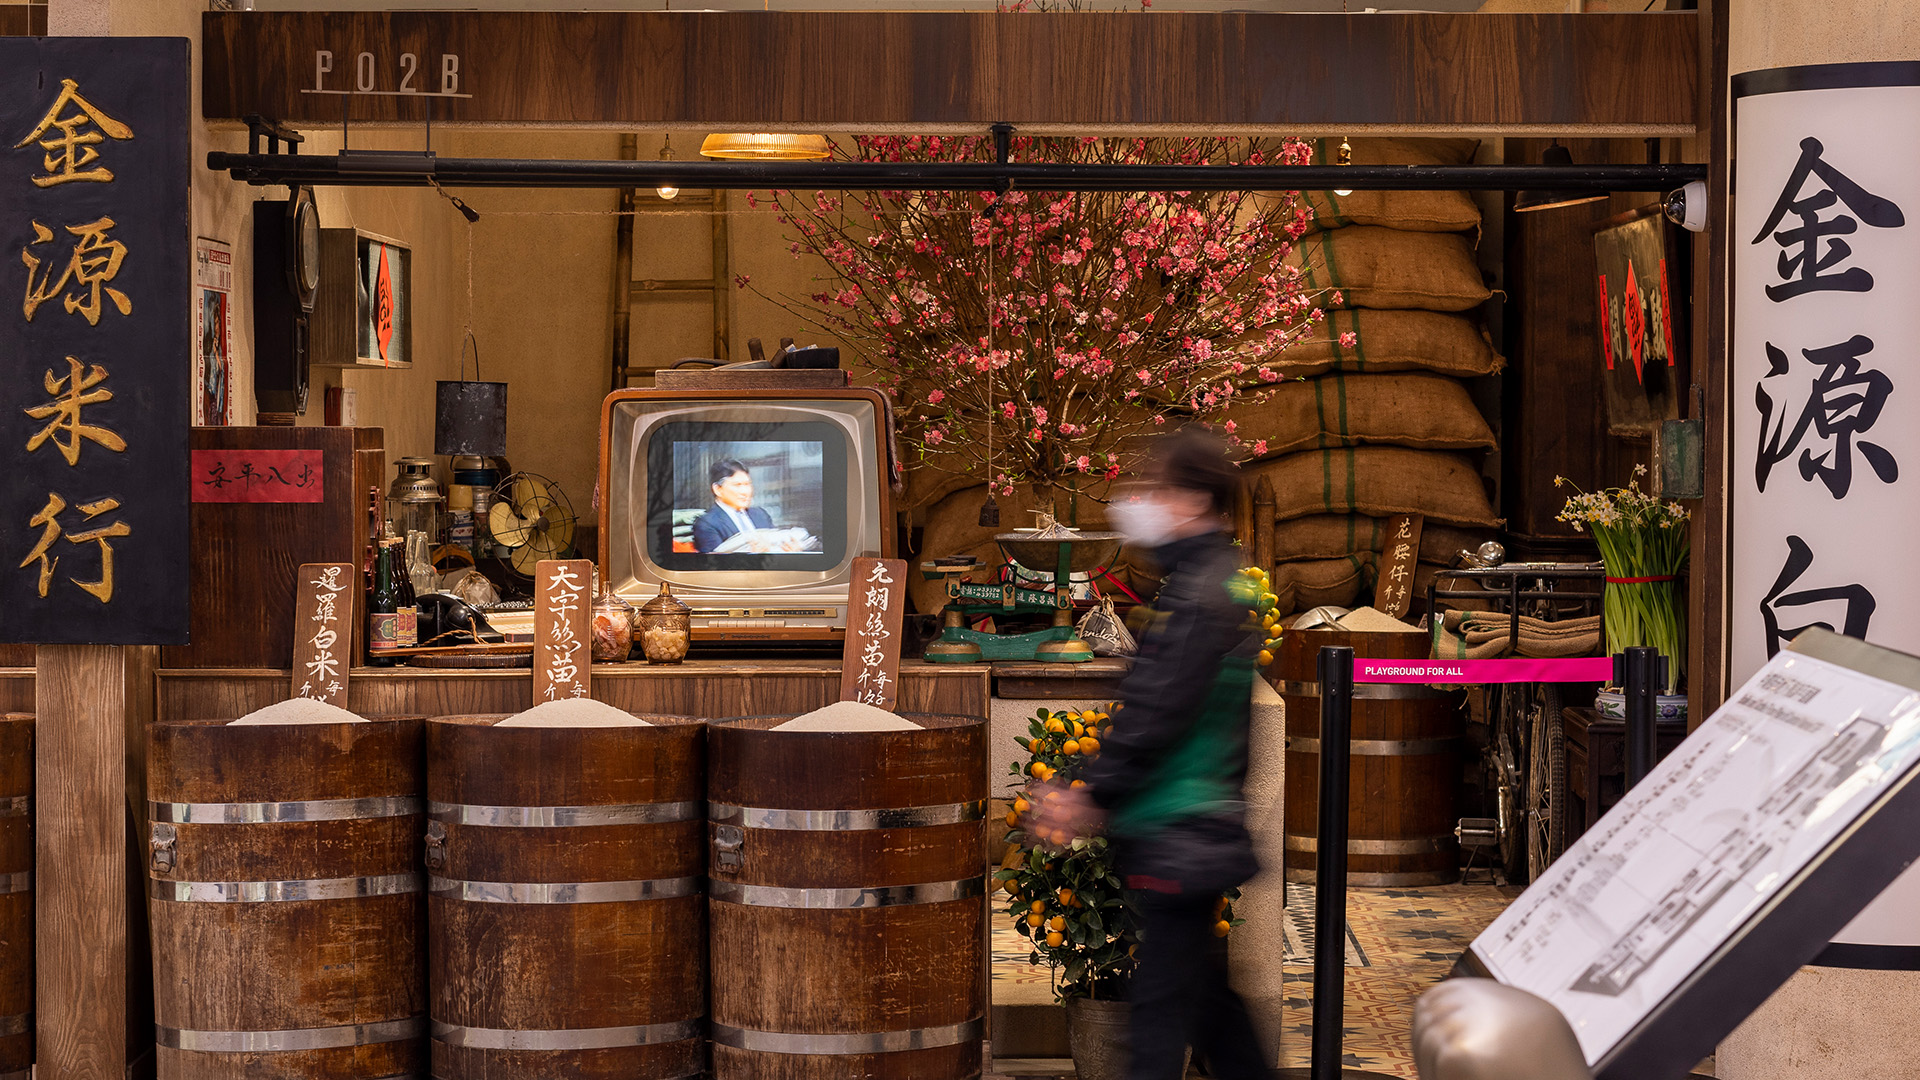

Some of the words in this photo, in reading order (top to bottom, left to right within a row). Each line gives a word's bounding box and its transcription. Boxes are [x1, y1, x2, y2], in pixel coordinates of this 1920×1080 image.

[14, 78, 135, 604] 金源米行
[305, 566, 348, 682] 暹羅白米
[545, 565, 585, 683] 天字絲苗
[1365, 666, 1425, 676] PLAYGROUND
[1427, 667, 1444, 676] FOR
[1446, 667, 1464, 676] ALL
